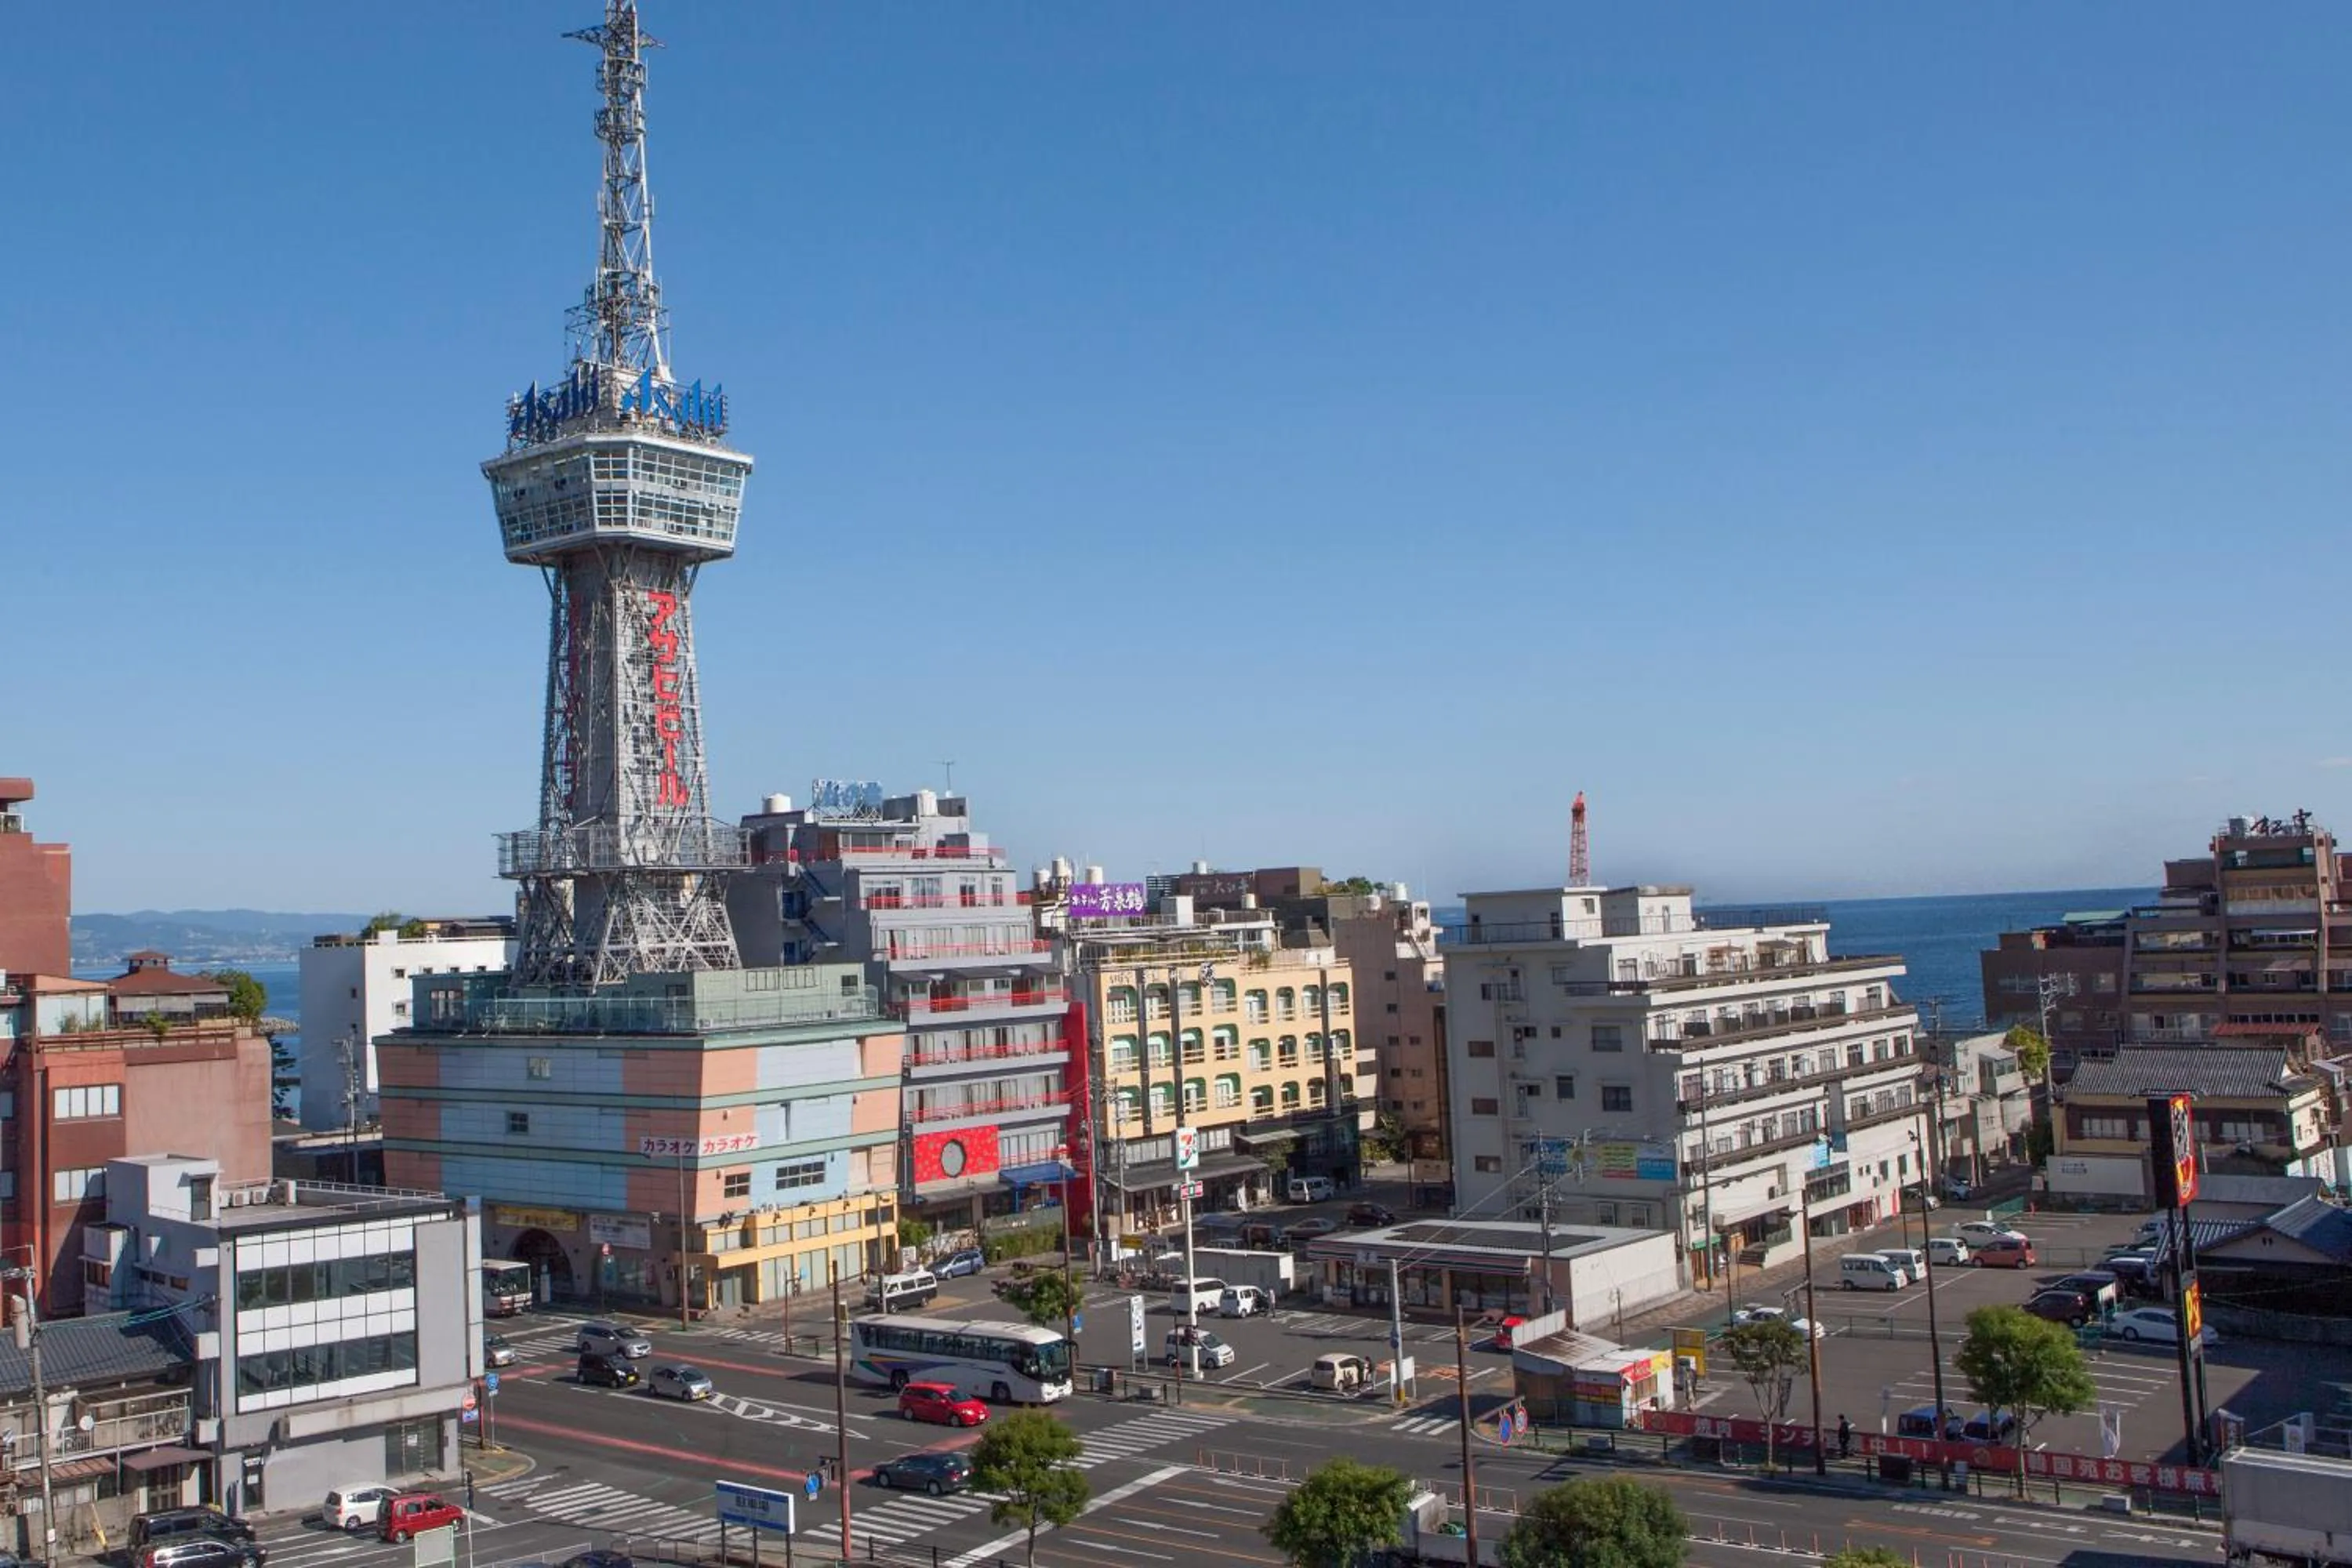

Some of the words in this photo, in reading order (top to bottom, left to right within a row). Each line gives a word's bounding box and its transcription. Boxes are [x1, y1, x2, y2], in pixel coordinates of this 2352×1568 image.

[648, 590, 690, 806] アサヒビール
[644, 1138, 696, 1154] カラオケ
[703, 1135, 757, 1154] カラオケ
